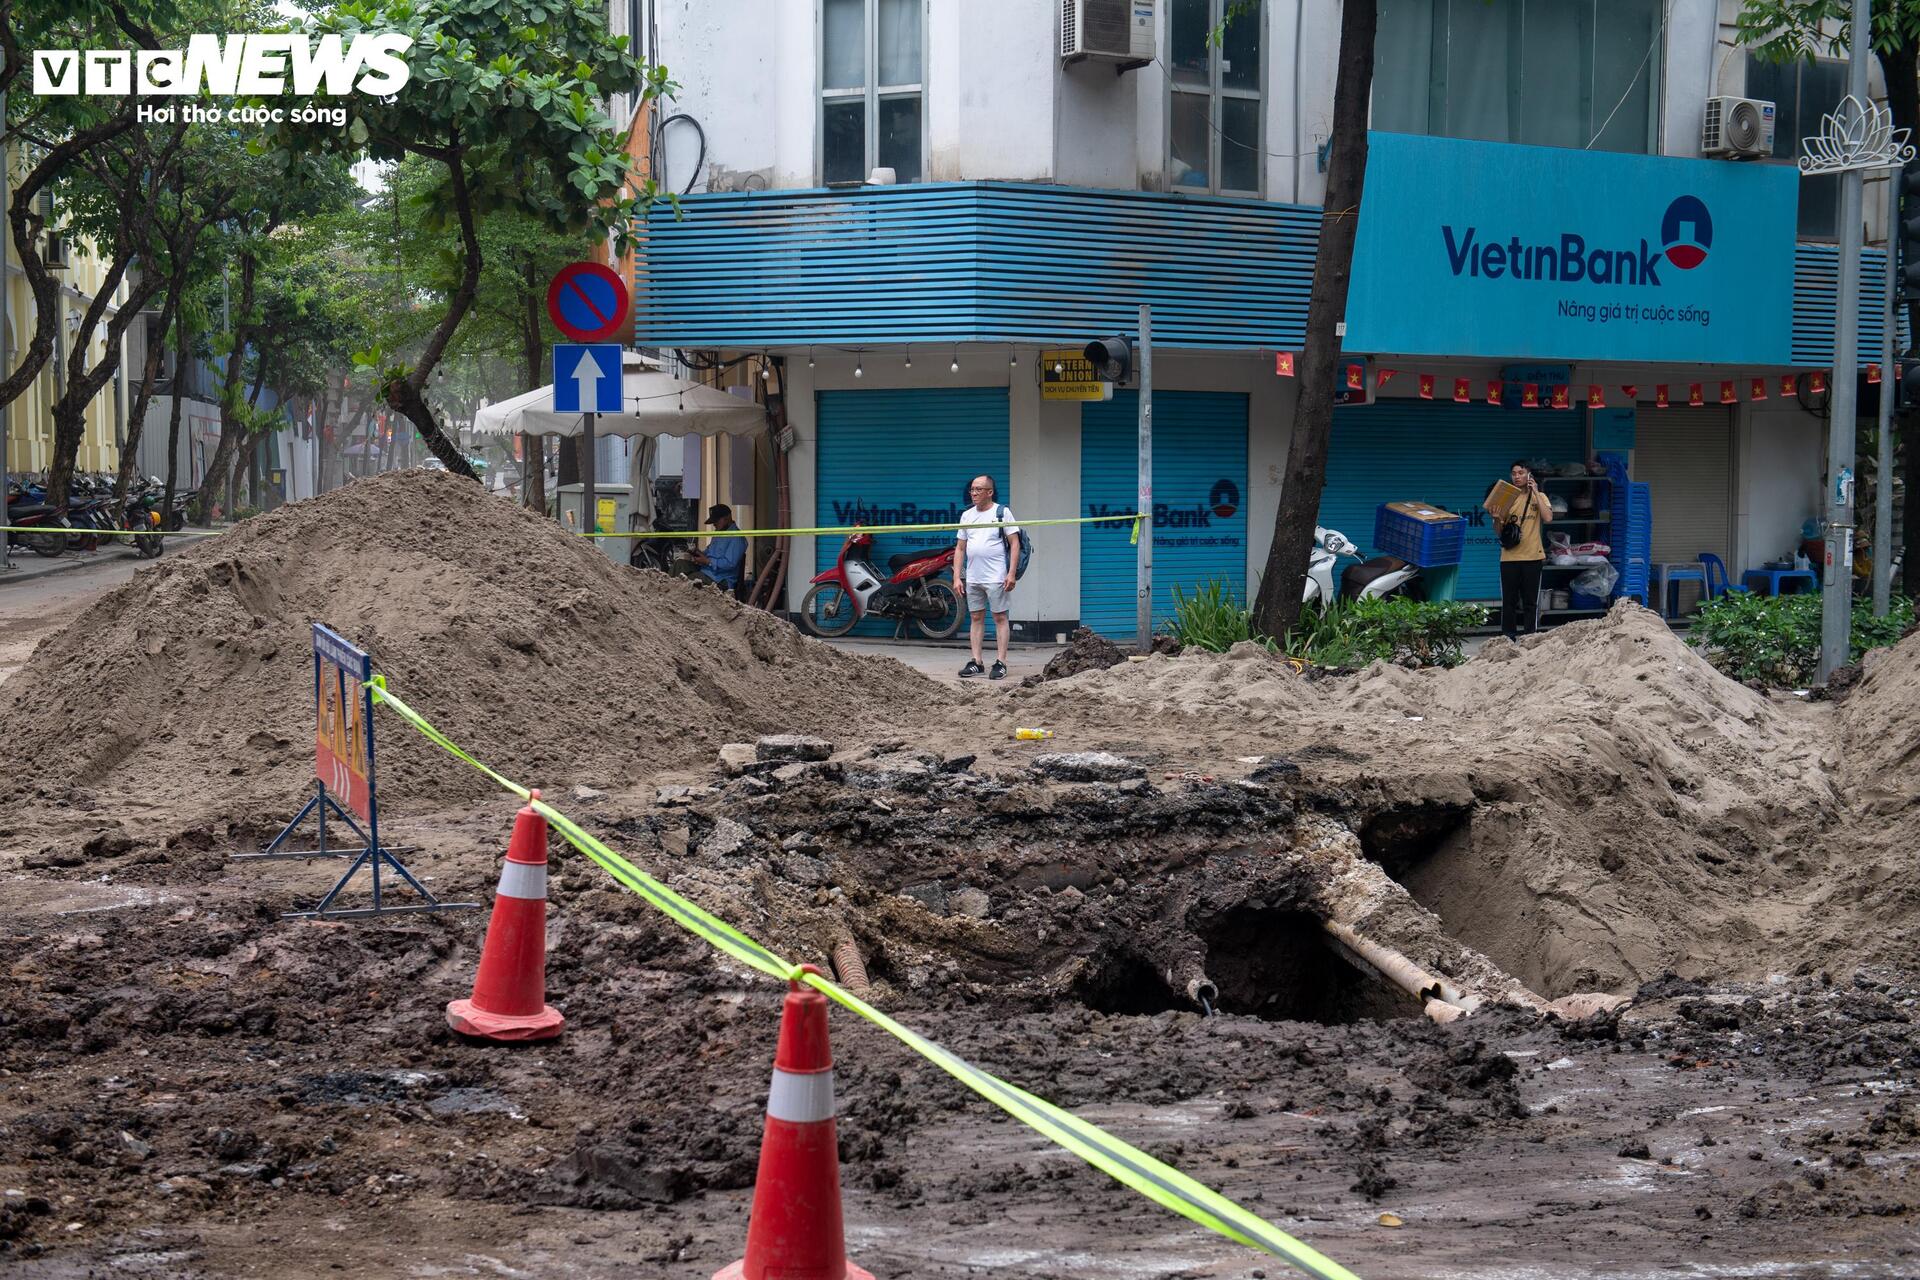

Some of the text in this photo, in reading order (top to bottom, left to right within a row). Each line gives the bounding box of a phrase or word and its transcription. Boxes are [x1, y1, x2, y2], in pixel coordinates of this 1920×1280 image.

[1441, 225, 1663, 287] VietinBank
[1557, 299, 1710, 327] Nâng giá trị cuộc sống
[1059, 370, 1092, 381] UNION
